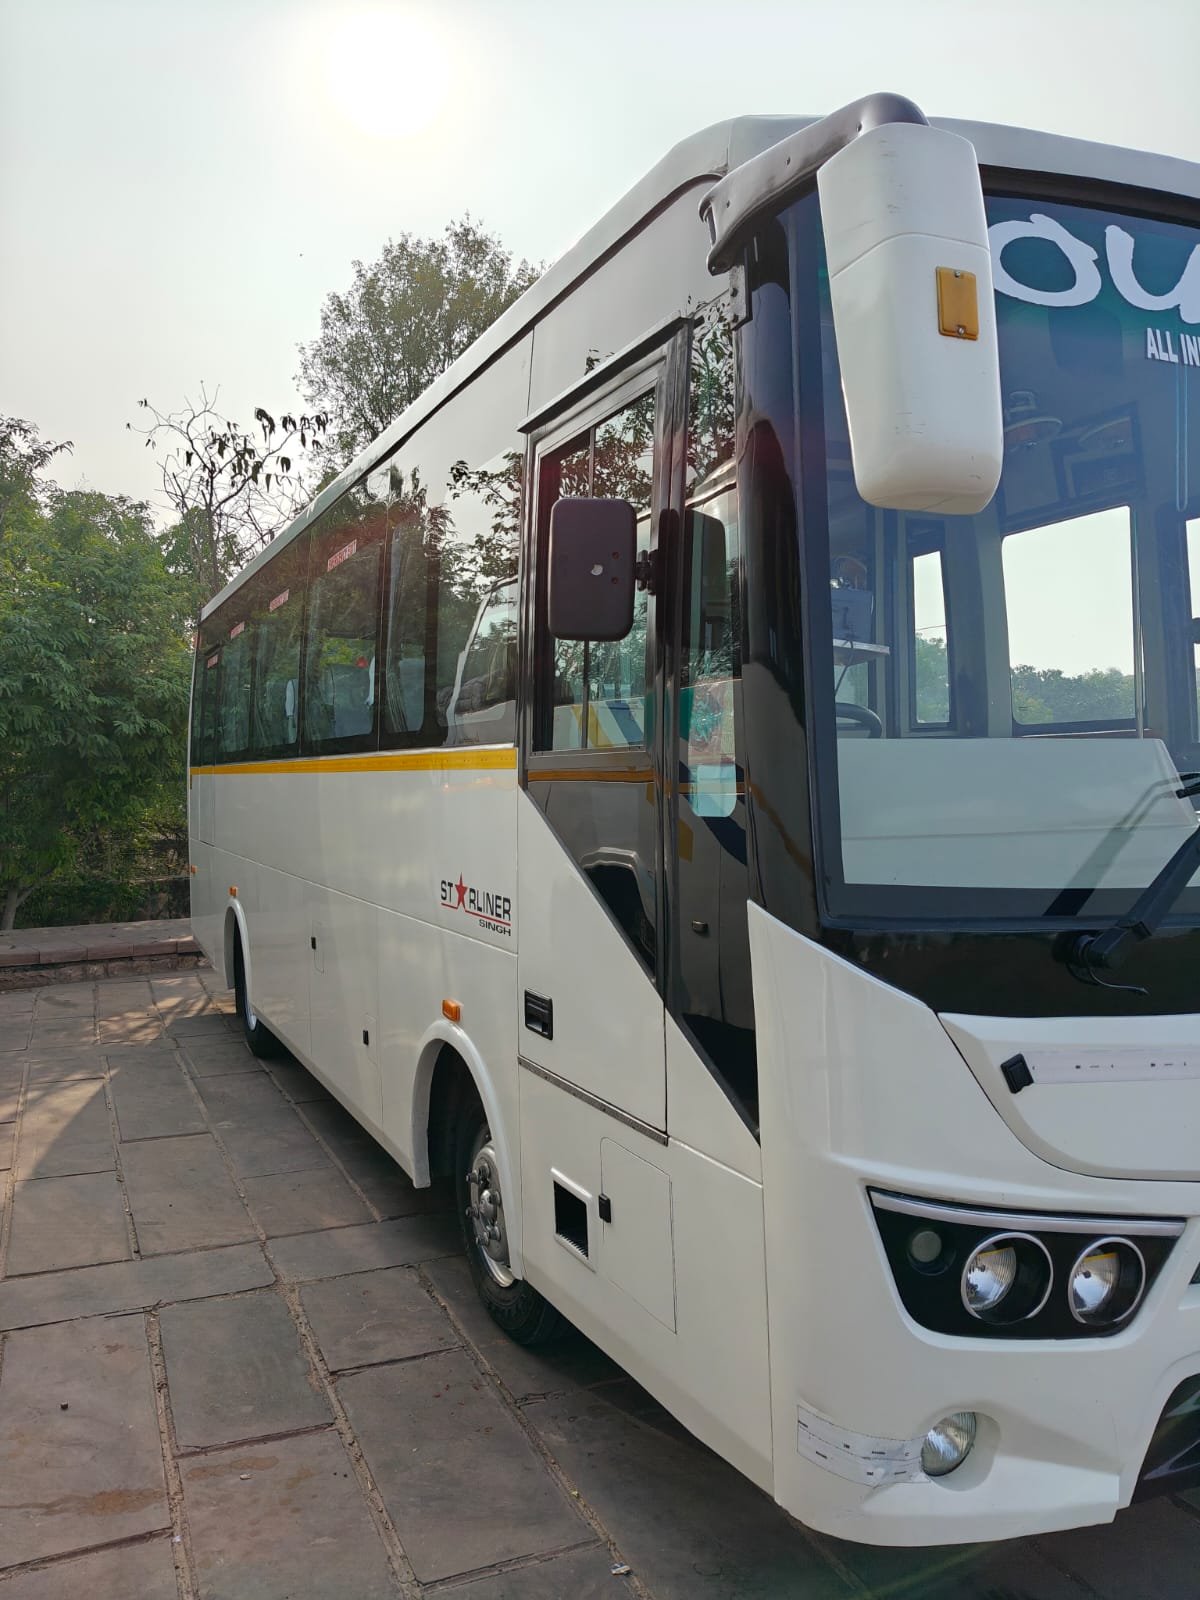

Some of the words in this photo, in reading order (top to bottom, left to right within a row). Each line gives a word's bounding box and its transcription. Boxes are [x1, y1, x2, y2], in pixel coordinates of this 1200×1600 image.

[1146, 327, 1179, 364] ALL
[1180, 333, 1200, 367] IN
[479, 919, 512, 936] SINGH
